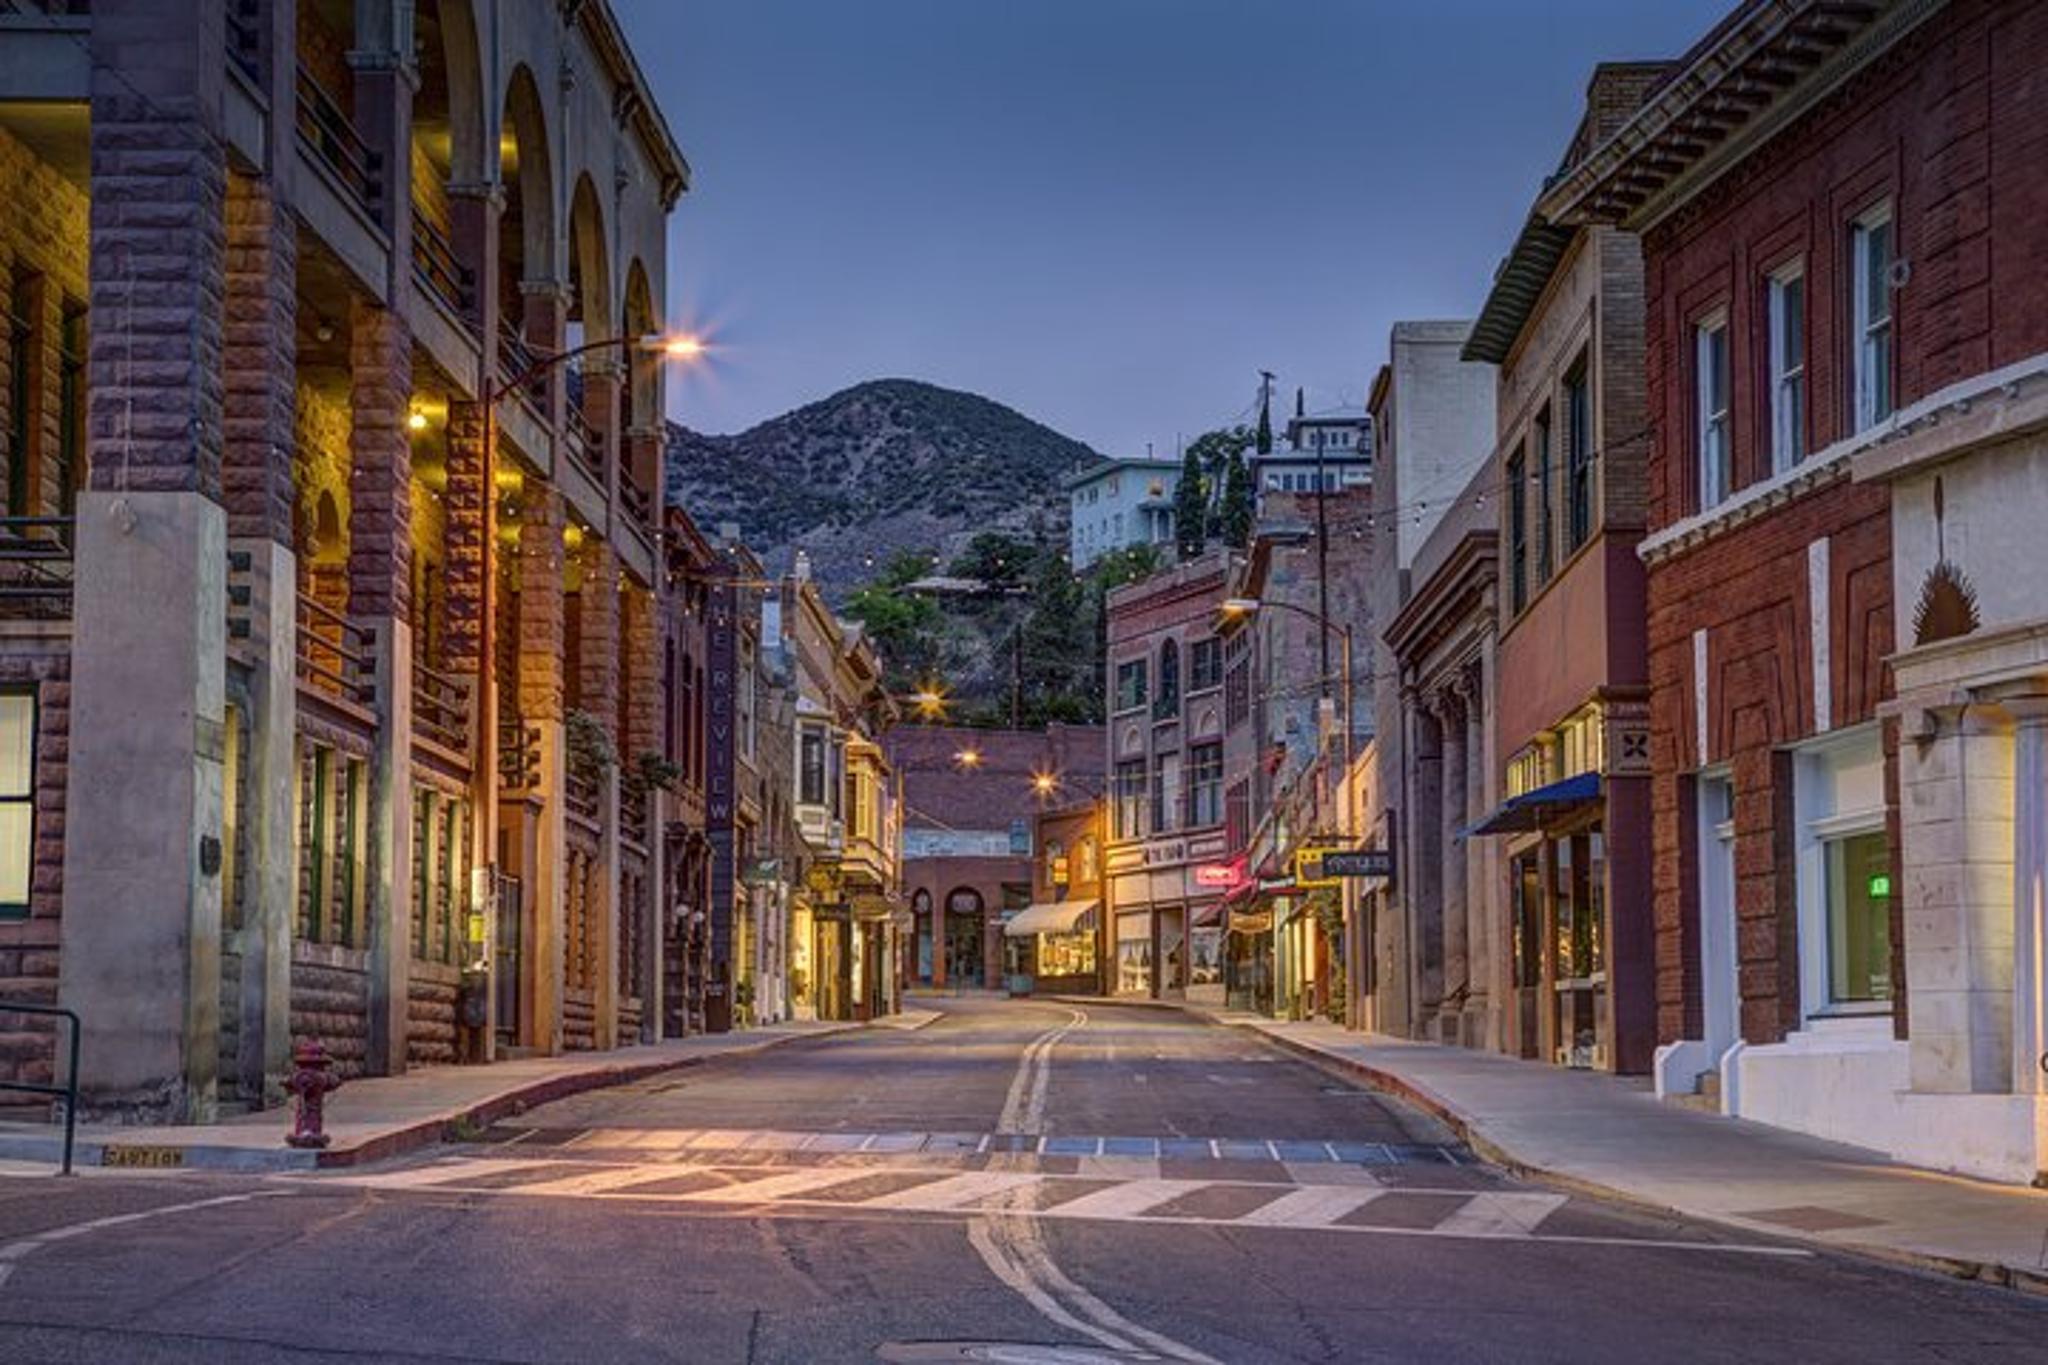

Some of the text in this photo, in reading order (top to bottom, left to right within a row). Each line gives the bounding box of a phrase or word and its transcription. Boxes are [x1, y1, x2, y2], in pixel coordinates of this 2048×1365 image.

[711, 581, 730, 820] HE REVIEW
[105, 1147, 183, 1167] CAUTION
